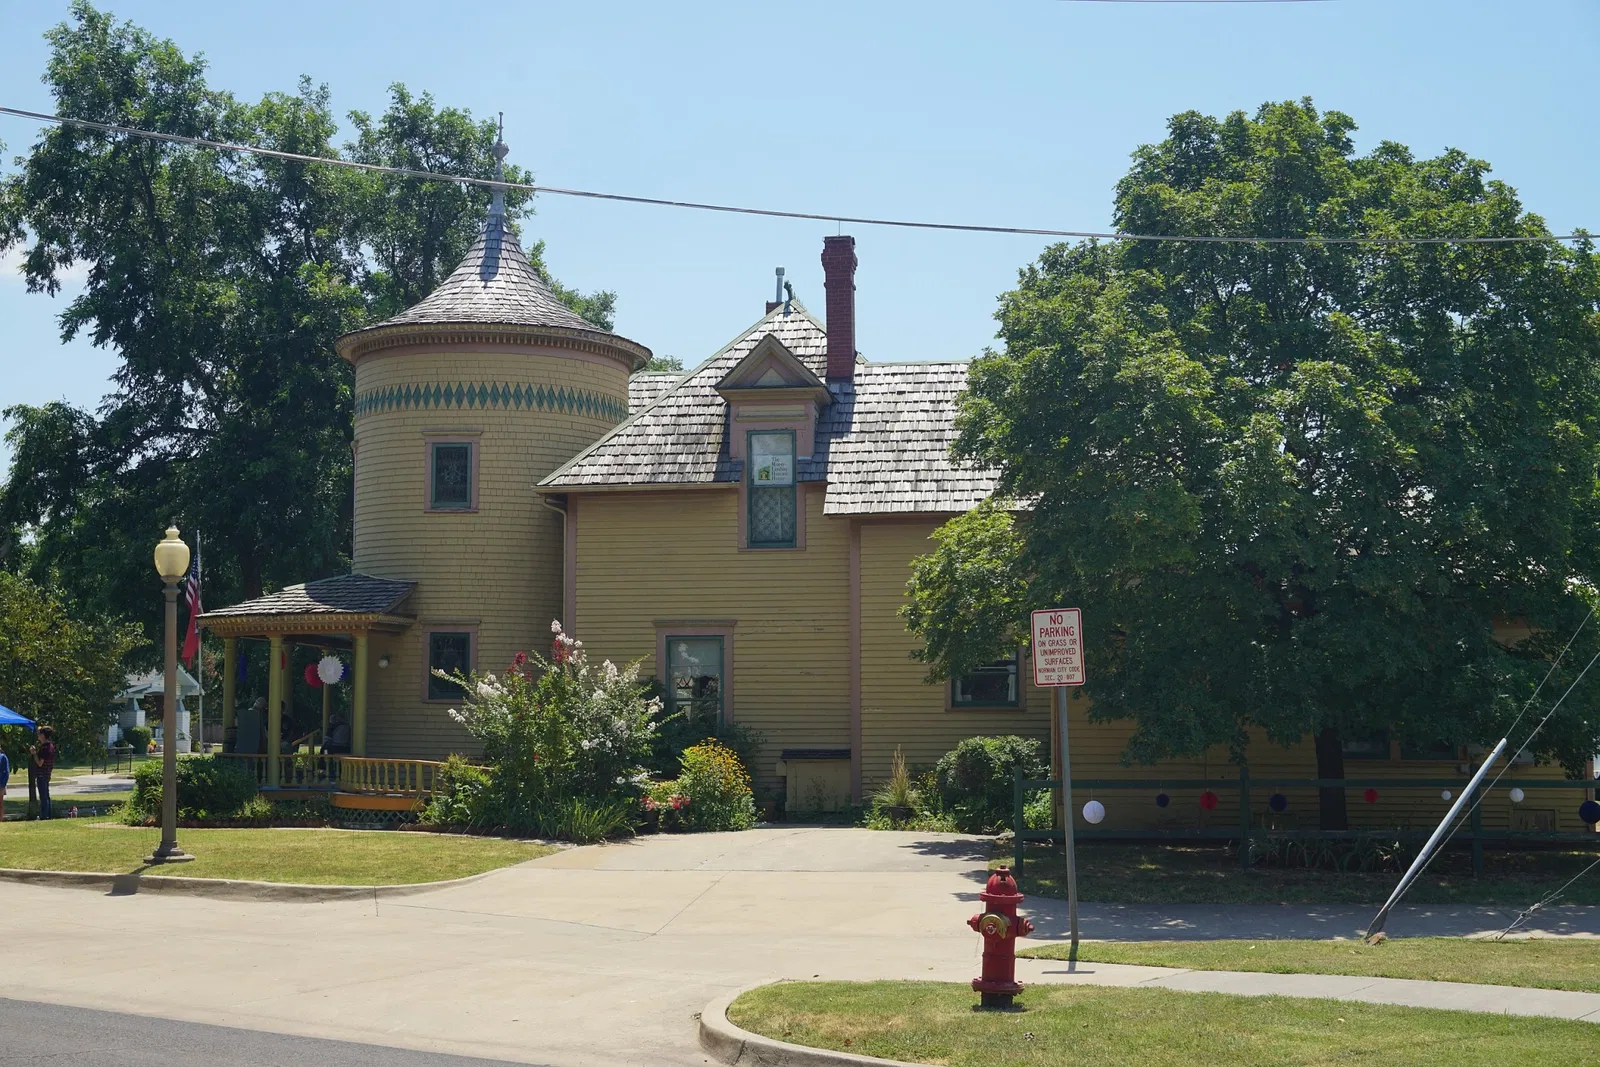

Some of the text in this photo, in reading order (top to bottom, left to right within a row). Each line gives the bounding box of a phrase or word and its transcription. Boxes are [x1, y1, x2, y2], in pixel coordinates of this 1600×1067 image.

[1050, 614, 1063, 625] NO
[1040, 626, 1074, 638] PARKING
[1048, 638, 1066, 647] GRASS
[1069, 638, 1078, 646] OR
[1040, 648, 1076, 656] UNIMPROVED
[1044, 657, 1074, 666] SURFACES
